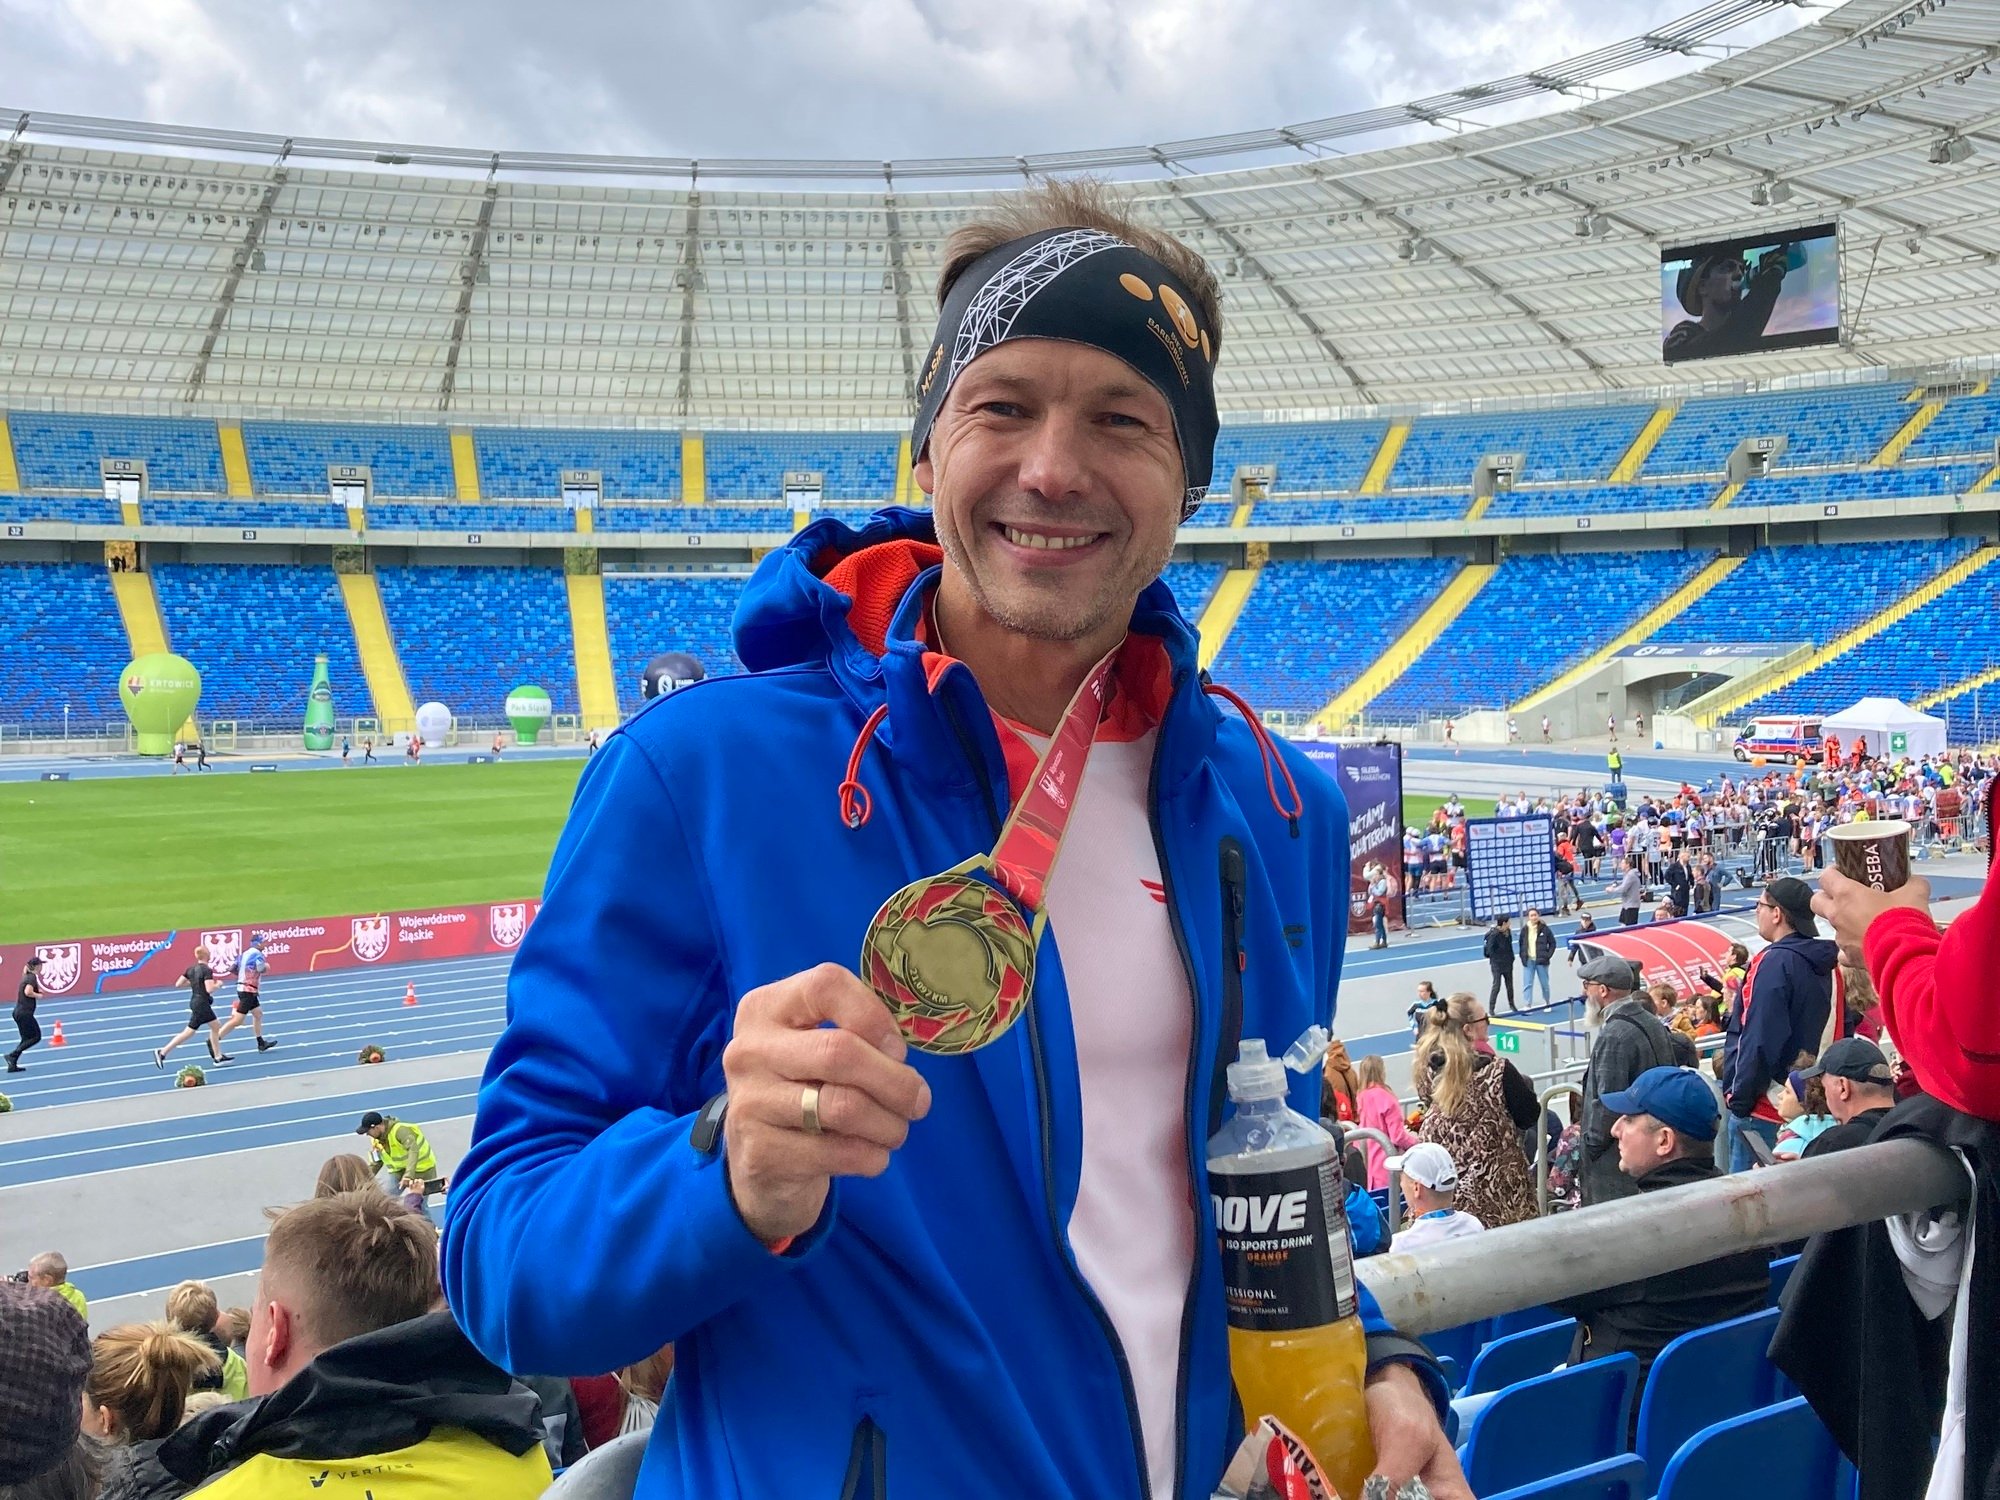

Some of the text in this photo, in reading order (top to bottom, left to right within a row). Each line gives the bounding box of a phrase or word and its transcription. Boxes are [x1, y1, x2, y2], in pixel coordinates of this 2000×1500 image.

[1826, 506, 1836, 515] 40
[10, 527, 21, 536] 32
[244, 531, 254, 540] 33
[1303, 749, 1335, 760] ództwo
[1350, 816, 1396, 861] OHATERÓW
[398, 913, 466, 928] Województwo
[398, 929, 434, 943] Śląskie
[91, 939, 171, 957] Województwo
[262, 942, 290, 957] ąskie
[91, 957, 134, 972] Śląskie
[932, 992, 948, 1004] KM
[1500, 1035, 1515, 1051] 14
[1226, 1234, 1314, 1251] ISO SPORTS DRINK
[1247, 1250, 1289, 1261] ORANGE
